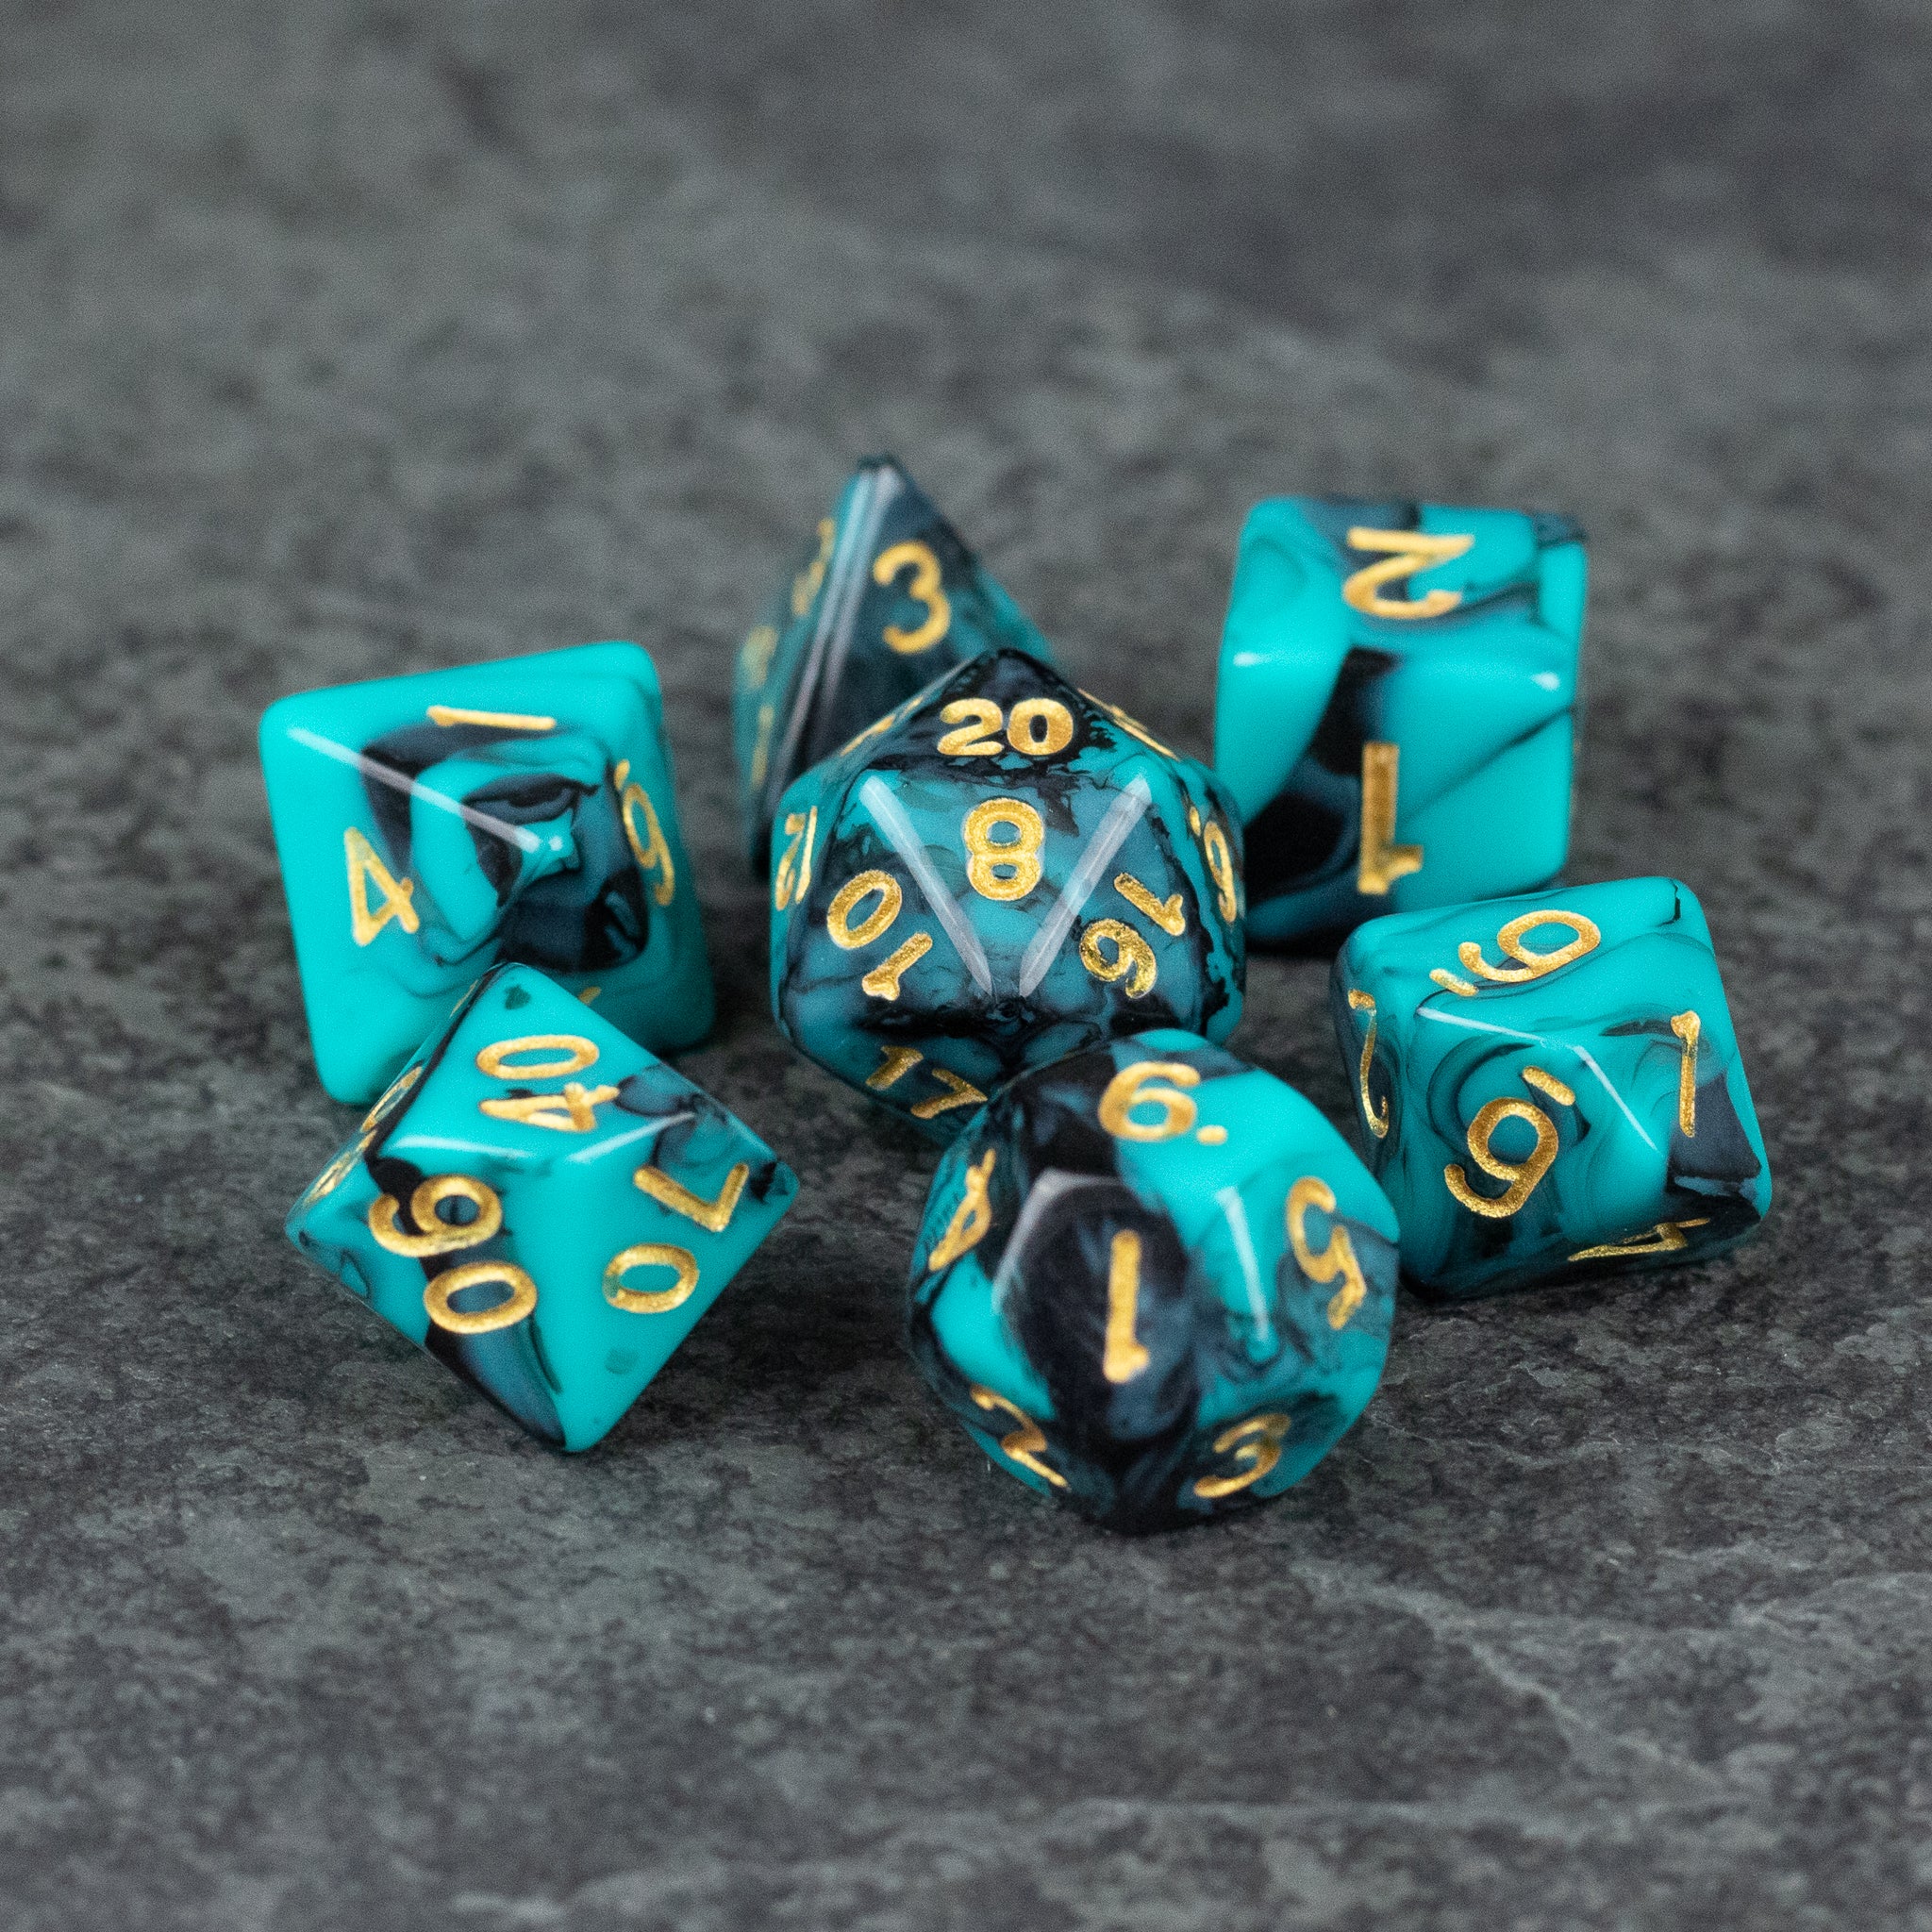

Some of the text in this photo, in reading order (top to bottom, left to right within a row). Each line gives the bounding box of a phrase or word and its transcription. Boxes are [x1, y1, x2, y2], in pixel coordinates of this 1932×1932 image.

[873, 540, 950, 654] 3
[1341, 525, 1475, 619] 2
[937, 698, 1074, 757] 20
[962, 797, 1044, 901] 8
[1357, 741, 1424, 895] 1
[344, 825, 420, 947] 4
[826, 869, 934, 1002] 10
[1079, 873, 1187, 999] 16
[475, 1034, 621, 1132] 40
[865, 1044, 989, 1120] 17
[1670, 1009, 1701, 1138] 1
[367, 1174, 538, 1336] 90
[602, 1162, 750, 1314] 70
[1102, 1228, 1150, 1383] 1
[1193, 1413, 1291, 1499] 3
